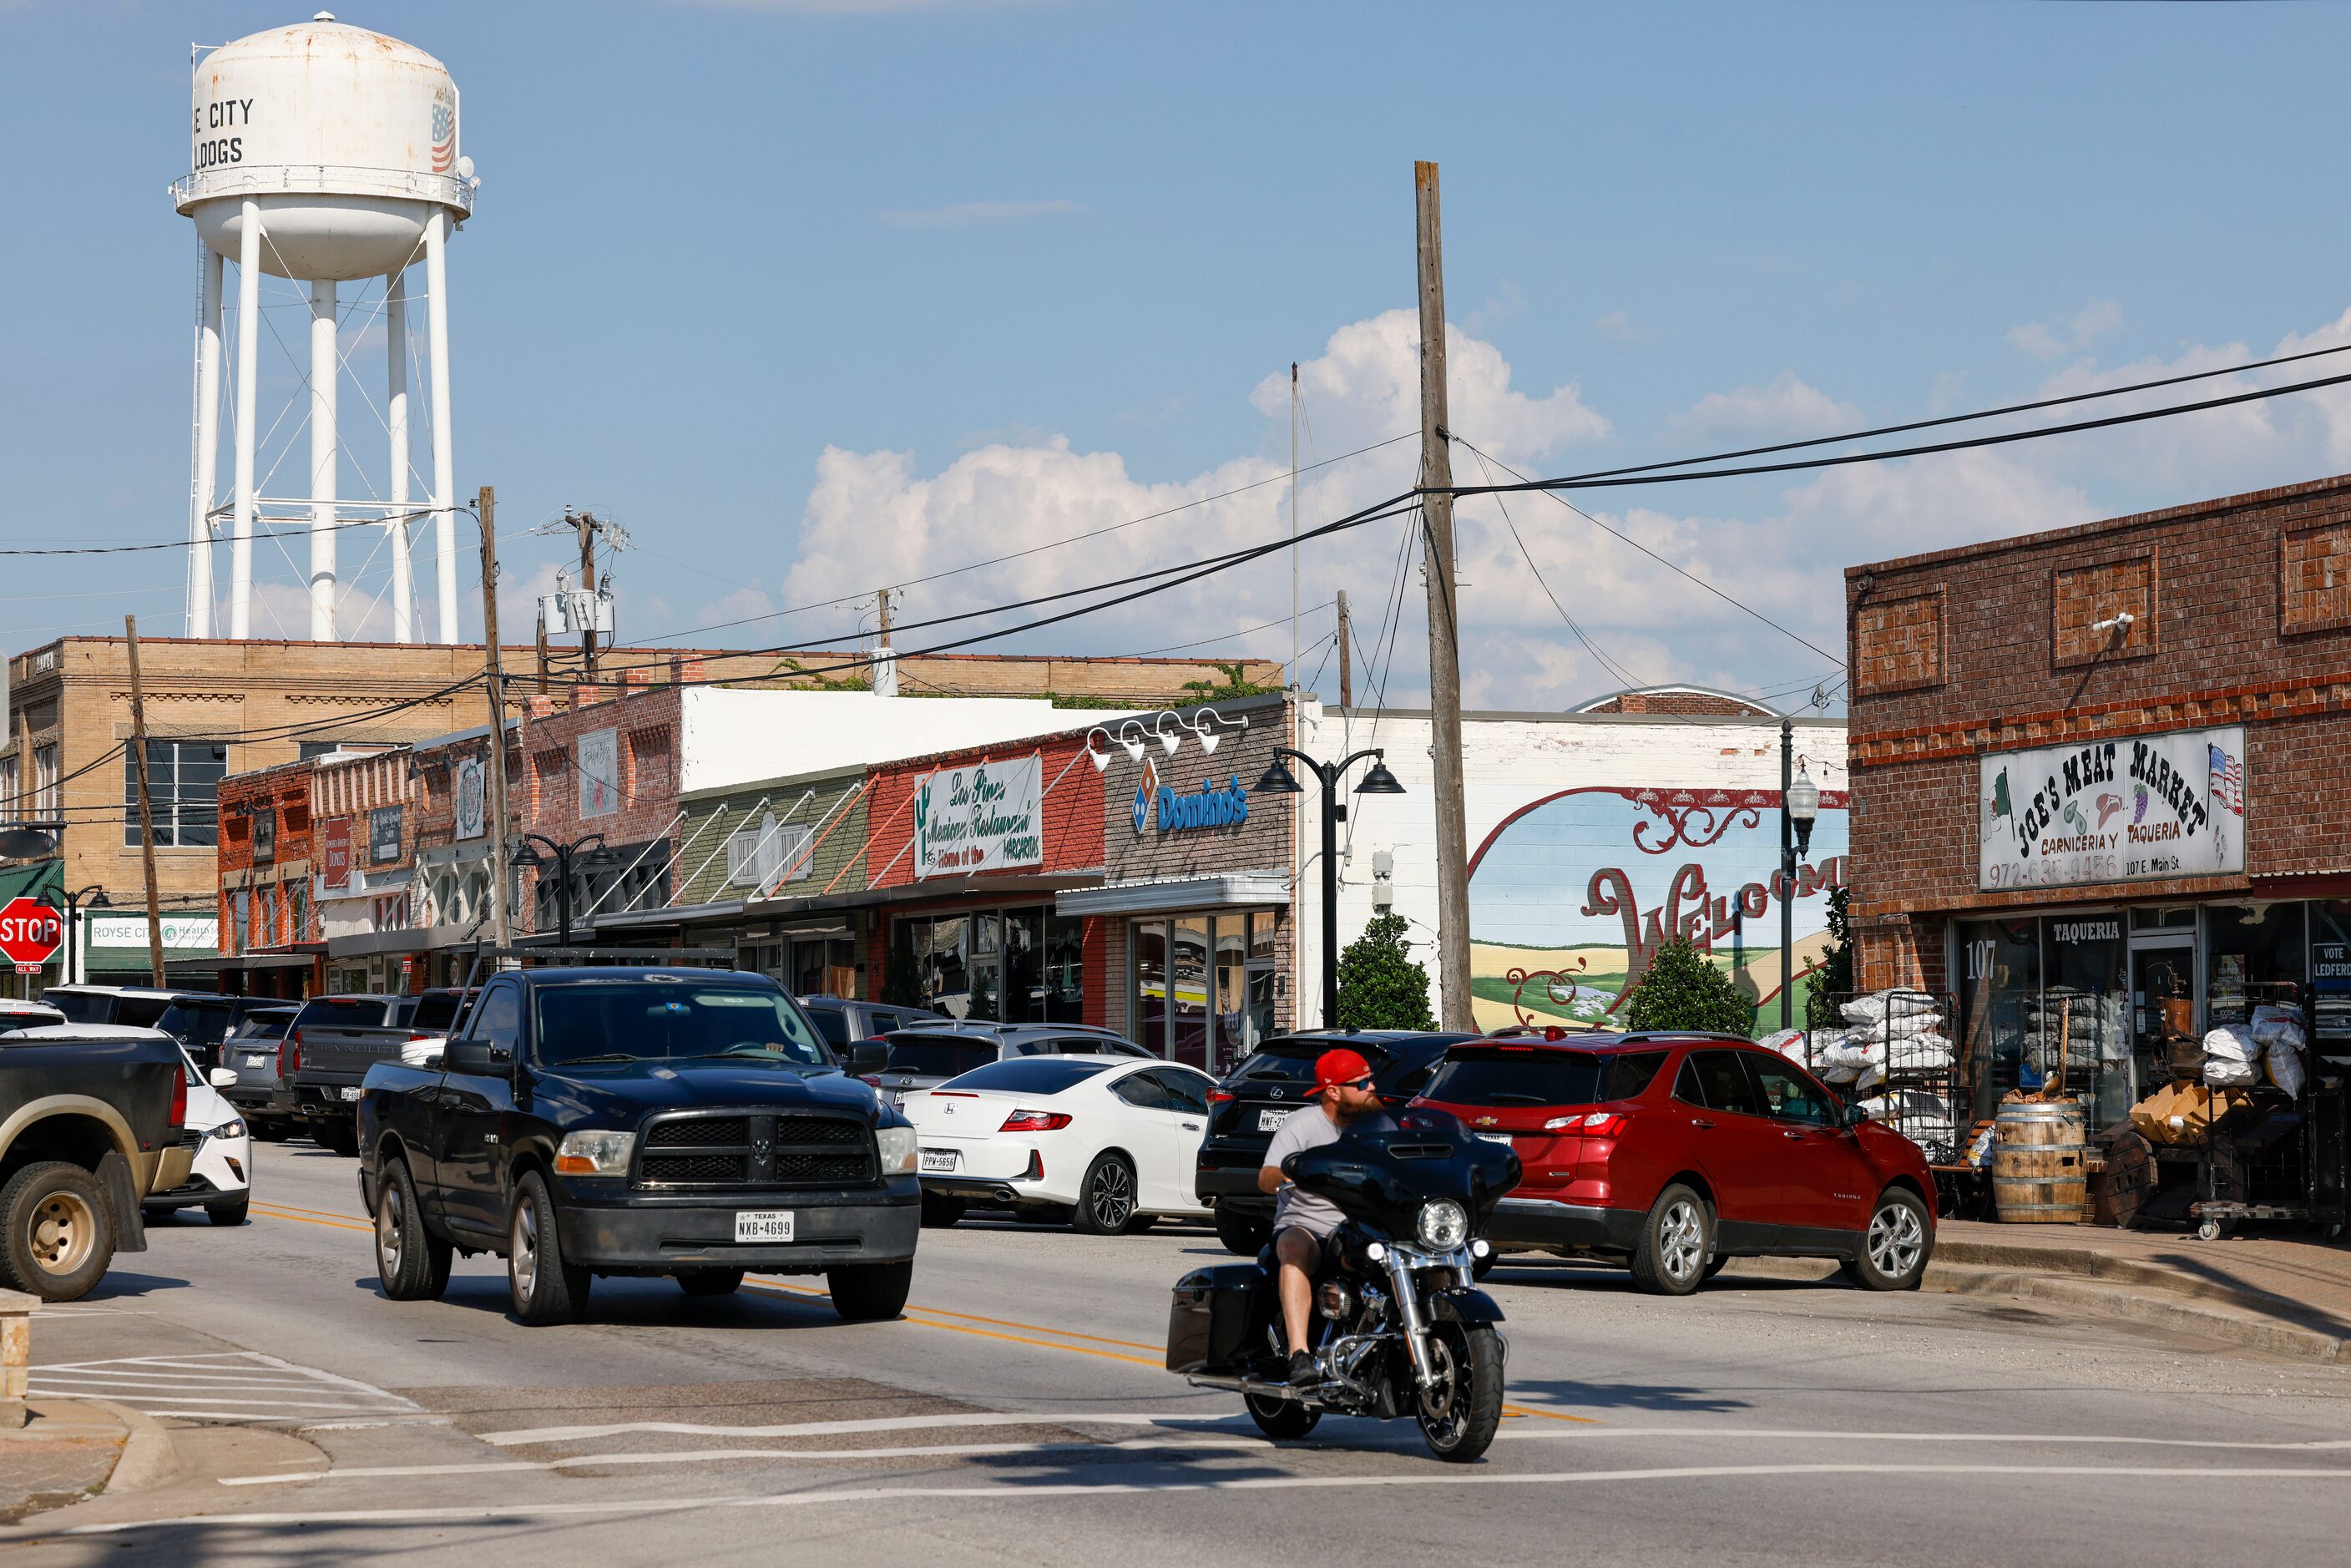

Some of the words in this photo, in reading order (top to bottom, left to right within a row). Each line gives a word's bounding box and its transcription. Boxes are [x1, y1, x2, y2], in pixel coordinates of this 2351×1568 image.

[210, 99, 254, 128] CITY
[950, 772, 972, 807] Los
[972, 768, 1006, 804] Pinos
[2019, 776, 2060, 858] JOE'S
[2062, 743, 2116, 797] MEAT
[2130, 741, 2207, 837] MARKET
[1159, 774, 1247, 831] Domino's
[928, 811, 968, 844] Mexican
[970, 800, 1032, 838] Restaurant
[1004, 836, 1039, 862] MARGARITAS
[2041, 834, 2106, 856] CARNICERIA
[2109, 832, 2119, 849] Y
[2127, 820, 2181, 845] TAQUERIA
[738, 838, 756, 877] BEER
[781, 832, 802, 873] WINE
[938, 849, 960, 868] Home
[962, 846, 969, 866] of
[971, 845, 984, 864] the
[2126, 861, 2140, 876] 107
[2141, 861, 2149, 873] E.
[2151, 857, 2170, 873] Main
[2172, 855, 2182, 870] St.
[1990, 854, 2117, 888] 972-635-9456
[0, 918, 58, 942] STOP
[94, 927, 132, 938] ROYSE
[134, 928, 150, 938] CIT
[179, 926, 210, 934] Health
[2054, 921, 2120, 945] TAQUERIA
[1966, 940, 1996, 979] 107
[2324, 948, 2344, 959] VOTE
